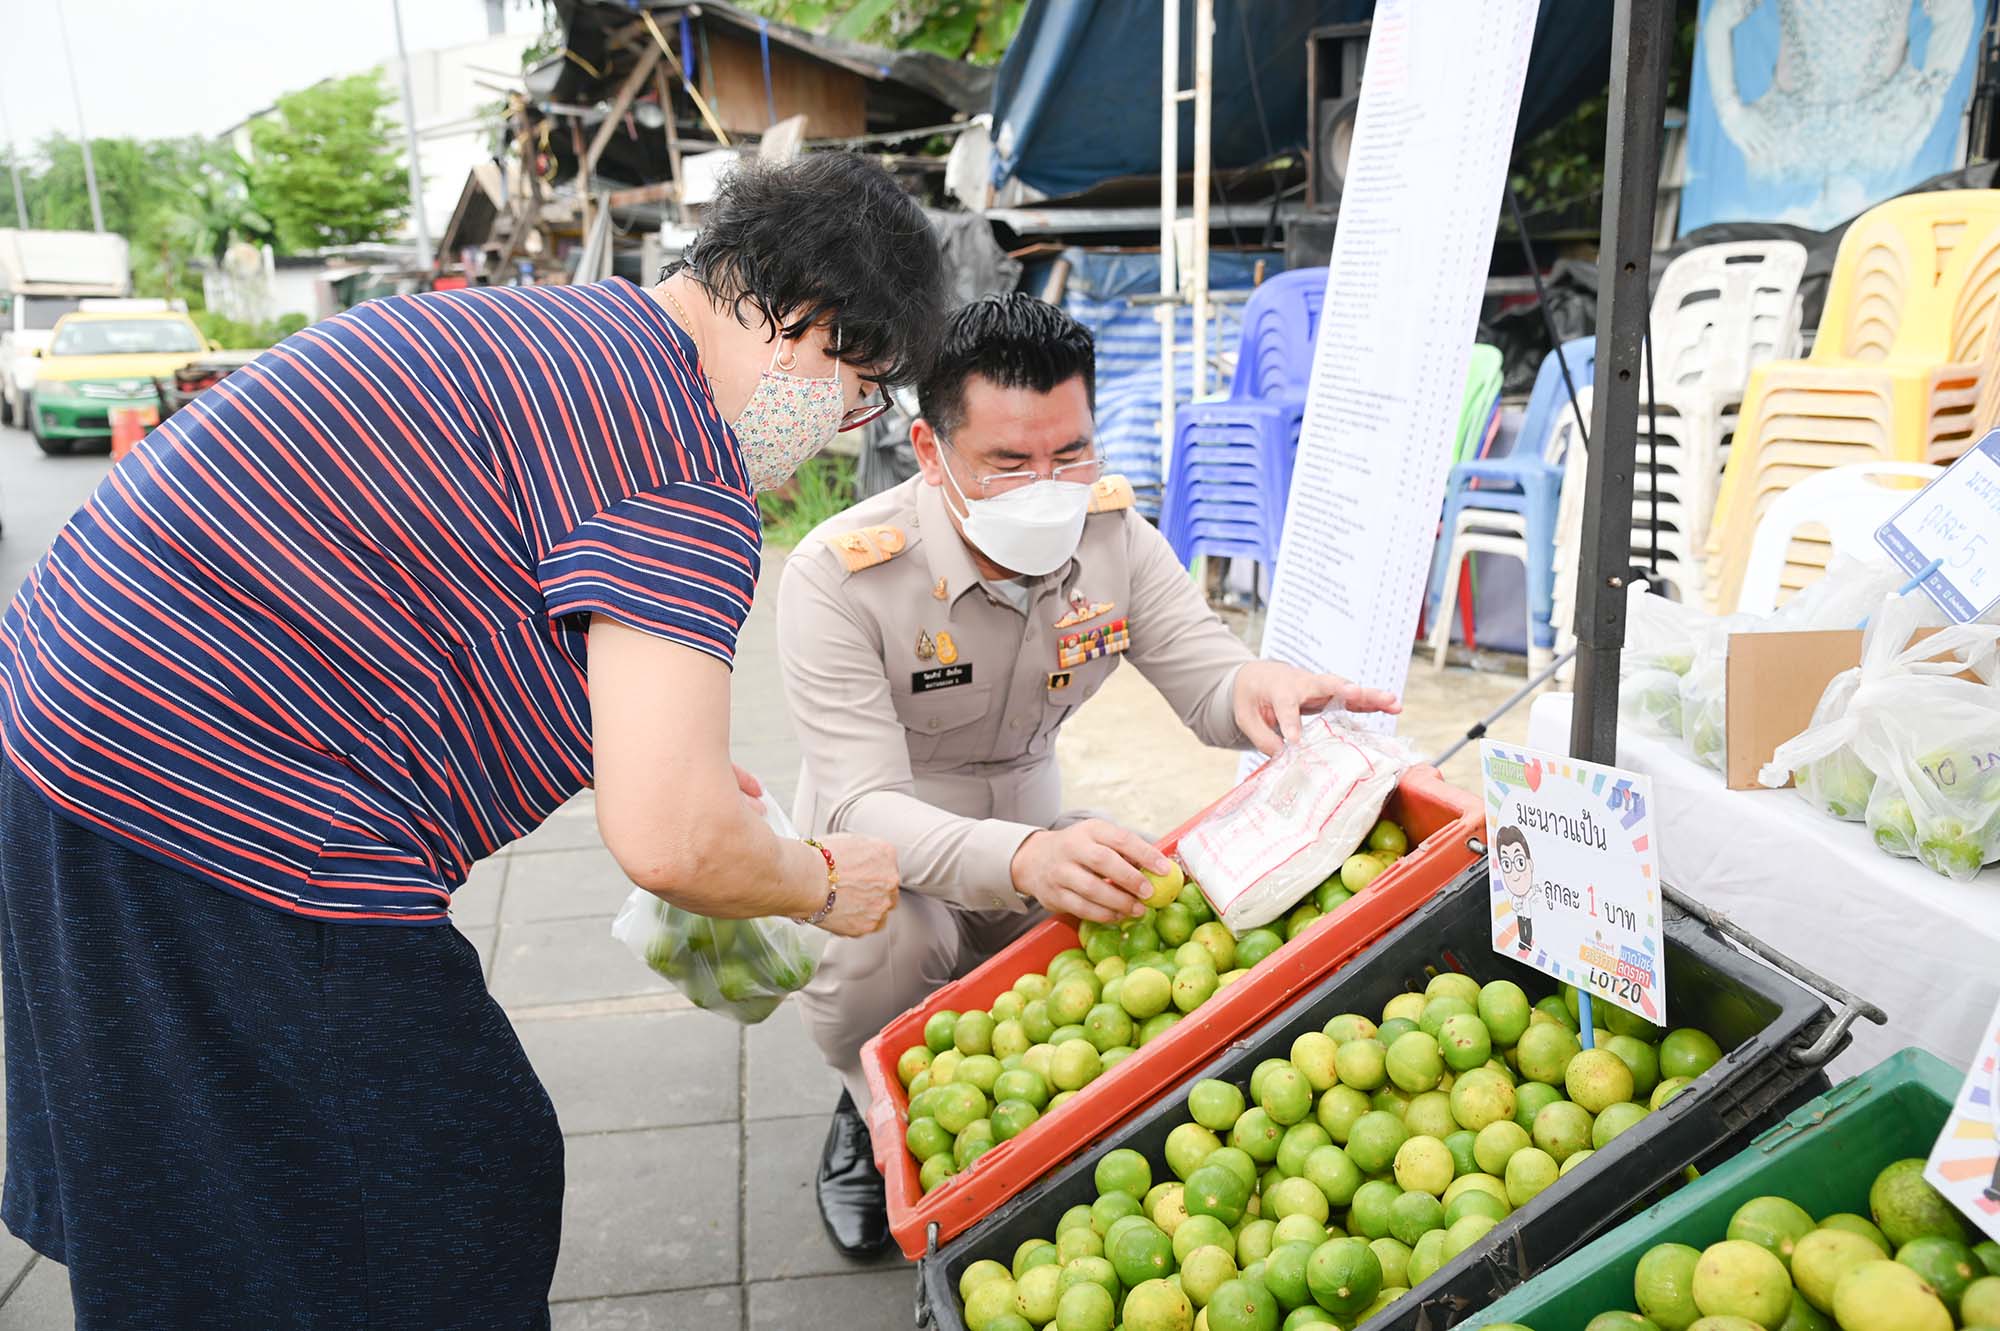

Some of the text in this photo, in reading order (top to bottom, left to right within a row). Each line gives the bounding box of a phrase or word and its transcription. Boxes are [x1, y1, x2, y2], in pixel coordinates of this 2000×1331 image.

[1949, 533, 1988, 569] 5
[1516, 802, 1608, 852] มะนาวแป้น
[1544, 879, 1637, 933] ลูกละ 1 บาท
[1589, 967, 1642, 1004] LOT20
[1617, 961, 1650, 986] ลดราคา
